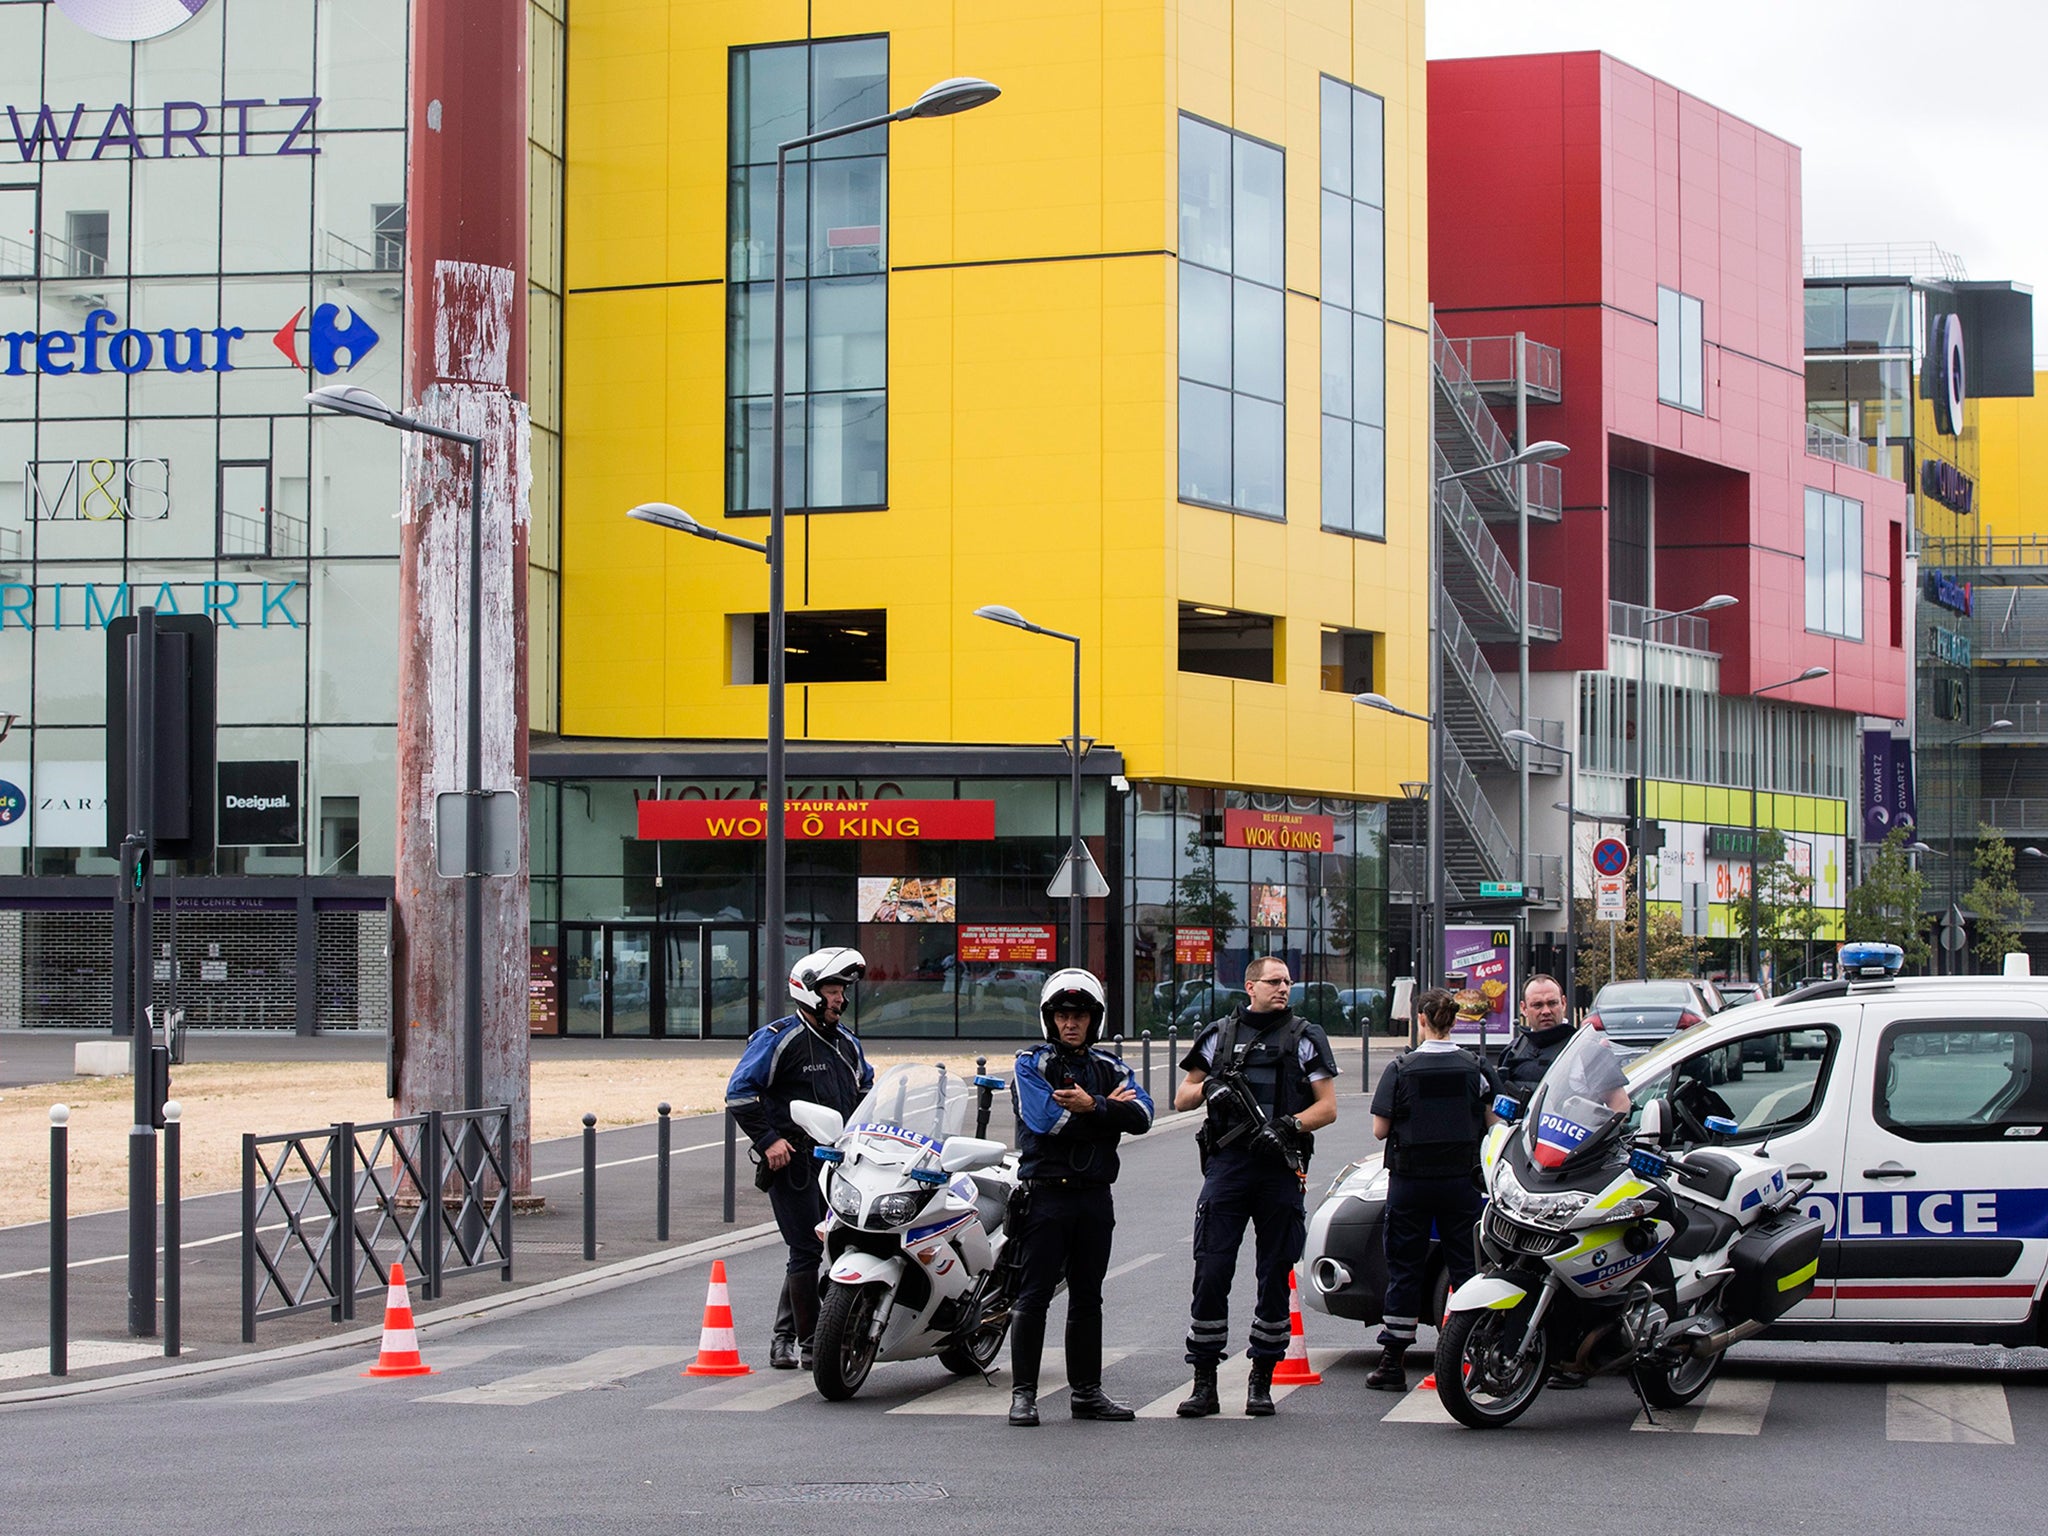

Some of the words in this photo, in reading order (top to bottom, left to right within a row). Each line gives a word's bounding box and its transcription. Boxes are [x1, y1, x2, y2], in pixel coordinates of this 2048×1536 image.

[7, 97, 322, 162] WARTZ
[0, 309, 245, 376] refour
[24, 458, 170, 520] M&S
[0, 580, 300, 631] RIMARK
[1873, 754, 1883, 803] QWARTZ
[1897, 762, 1907, 810] QWARTZ
[760, 802, 869, 812] RSTAURANT
[1262, 813, 1304, 825] RESTAURANT
[706, 817, 769, 837] WO
[801, 812, 825, 837] Ô
[839, 817, 920, 837] KING
[1244, 826, 1276, 847] WOK
[1280, 825, 1290, 848] Ô
[1291, 831, 1322, 849] KING
[176, 898, 199, 906] ORTE
[201, 898, 237, 907] CENTRE
[239, 898, 264, 907] VILLE
[802, 1063, 827, 1073] POLICE
[865, 1123, 924, 1142] POLICE
[1540, 1114, 1586, 1142] POLICE
[1791, 1193, 1998, 1235] OLICE
[1598, 1255, 1643, 1279] POLICE
